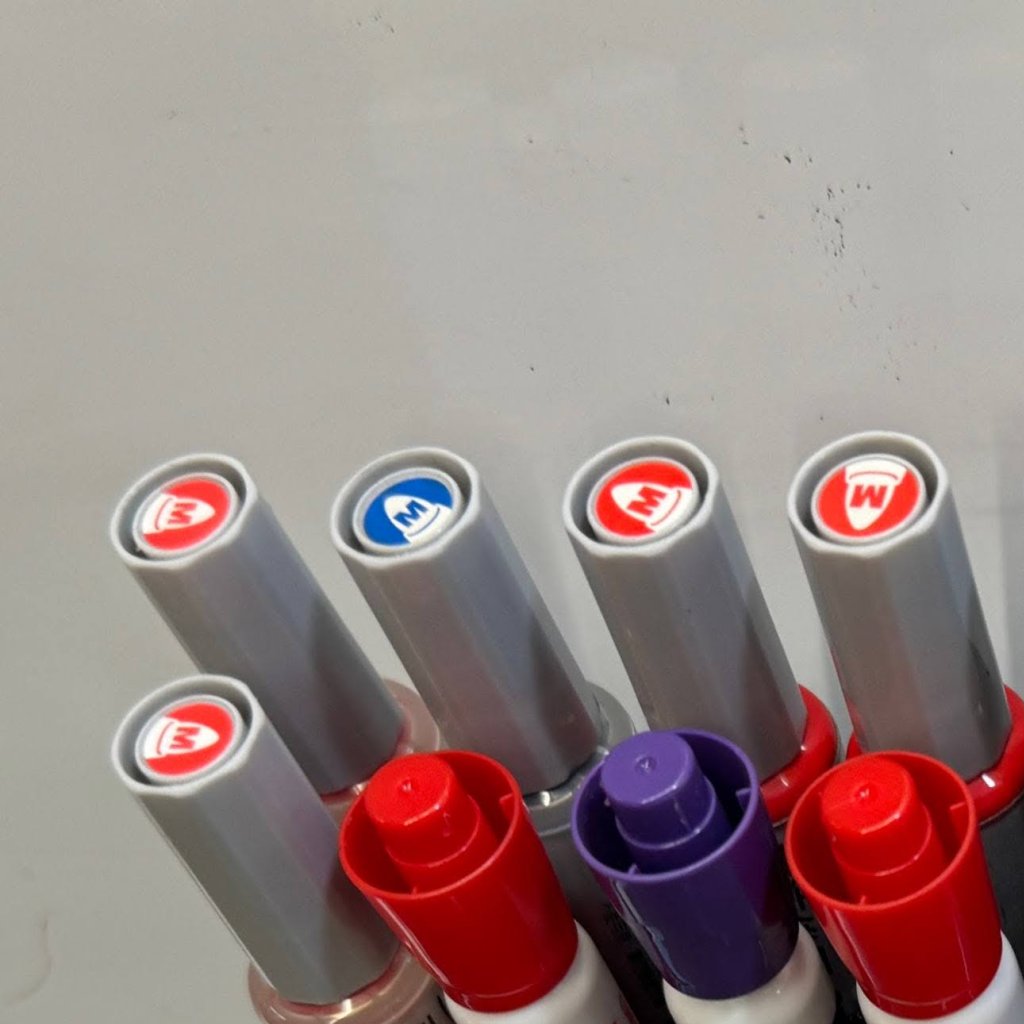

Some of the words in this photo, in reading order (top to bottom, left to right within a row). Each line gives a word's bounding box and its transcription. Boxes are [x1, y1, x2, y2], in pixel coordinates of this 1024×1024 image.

[626, 486, 666, 517] M
[849, 485, 884, 508] M
[167, 503, 197, 525] M
[394, 500, 428, 528] M
[170, 727, 200, 749] M
